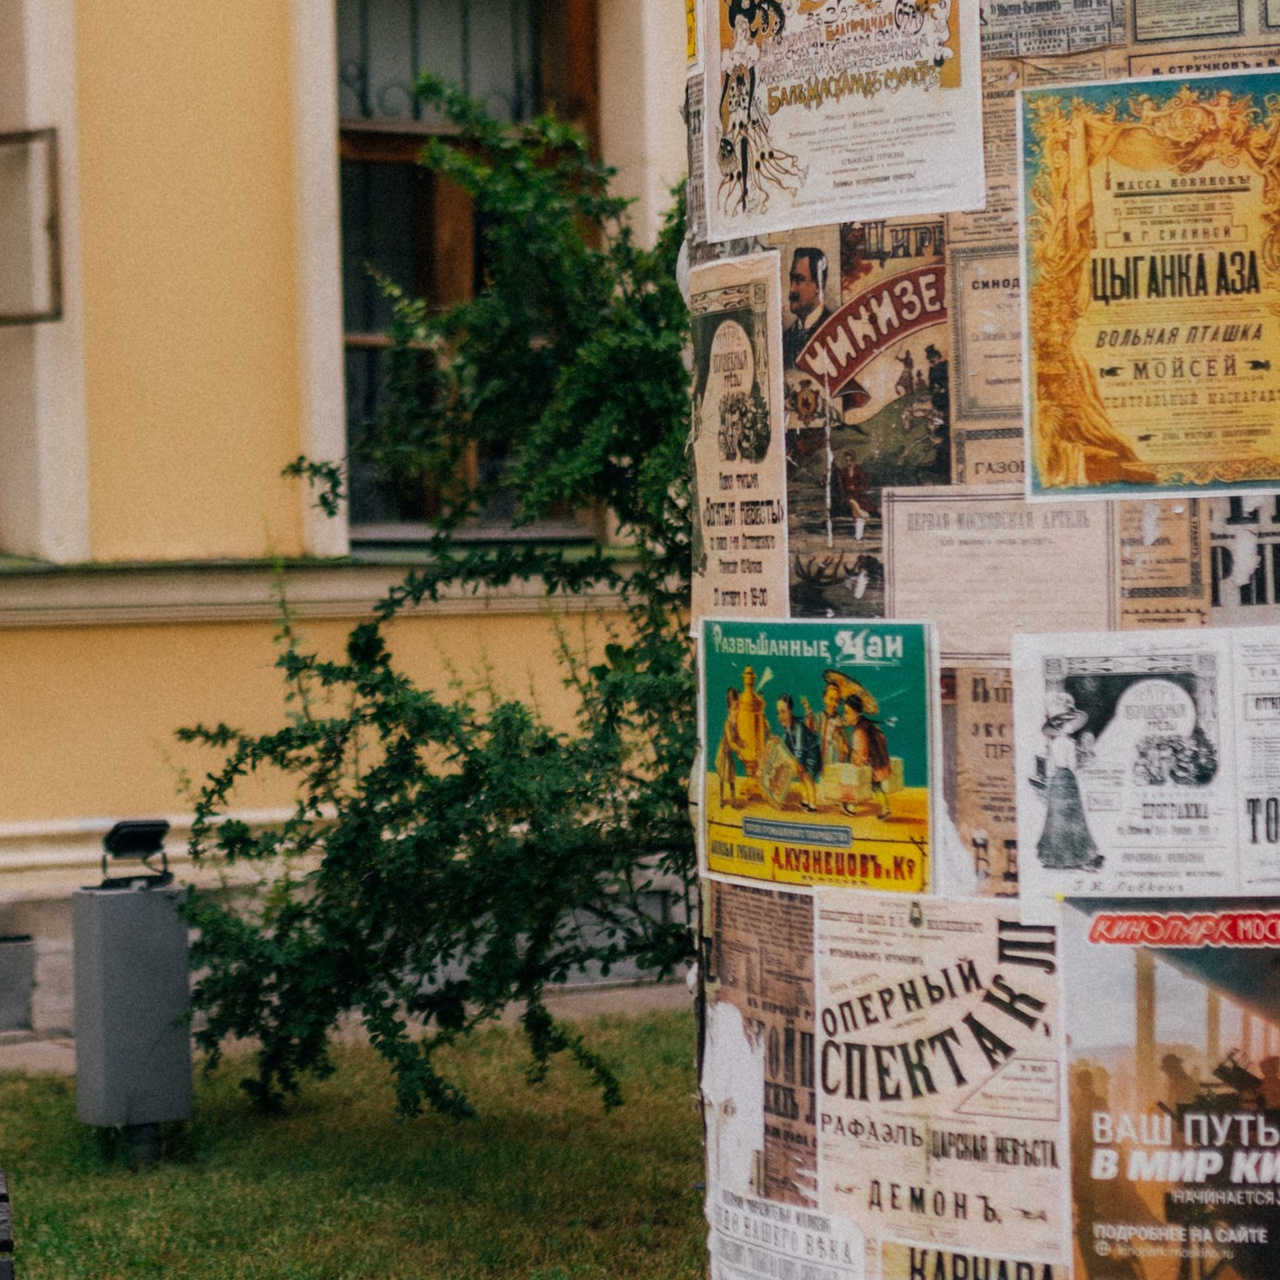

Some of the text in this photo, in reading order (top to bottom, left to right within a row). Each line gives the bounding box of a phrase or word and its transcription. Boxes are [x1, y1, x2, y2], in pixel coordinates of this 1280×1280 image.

[1170, 61, 1251, 75] СТРУЧКОВЪ
[1092, 251, 1260, 306] ЦЫГАНКА АЗА
[806, 273, 947, 378] ЧИНИЗЕ
[1096, 324, 1263, 348] ВОЛЬНАЯ ПТАШКА
[1133, 354, 1237, 380] МОЙСЕЙ
[1094, 919, 1234, 941] КИНОПАРК
[822, 958, 984, 1038] ОПЕРНЫЙ
[821, 1113, 924, 1148] РАФАЭЛЬ
[932, 1129, 988, 1163] ЦАРСКАЯ
[1092, 1112, 1280, 1147] ВАШ ПУТЬ
[1091, 1148, 1120, 1180] В
[1127, 1150, 1223, 1183] МИР
[1172, 1190, 1274, 1206] НАЧИНАЕТСЯ
[1094, 1224, 1268, 1244] ПОДРОБНЕЕ НА САЙТЕ
